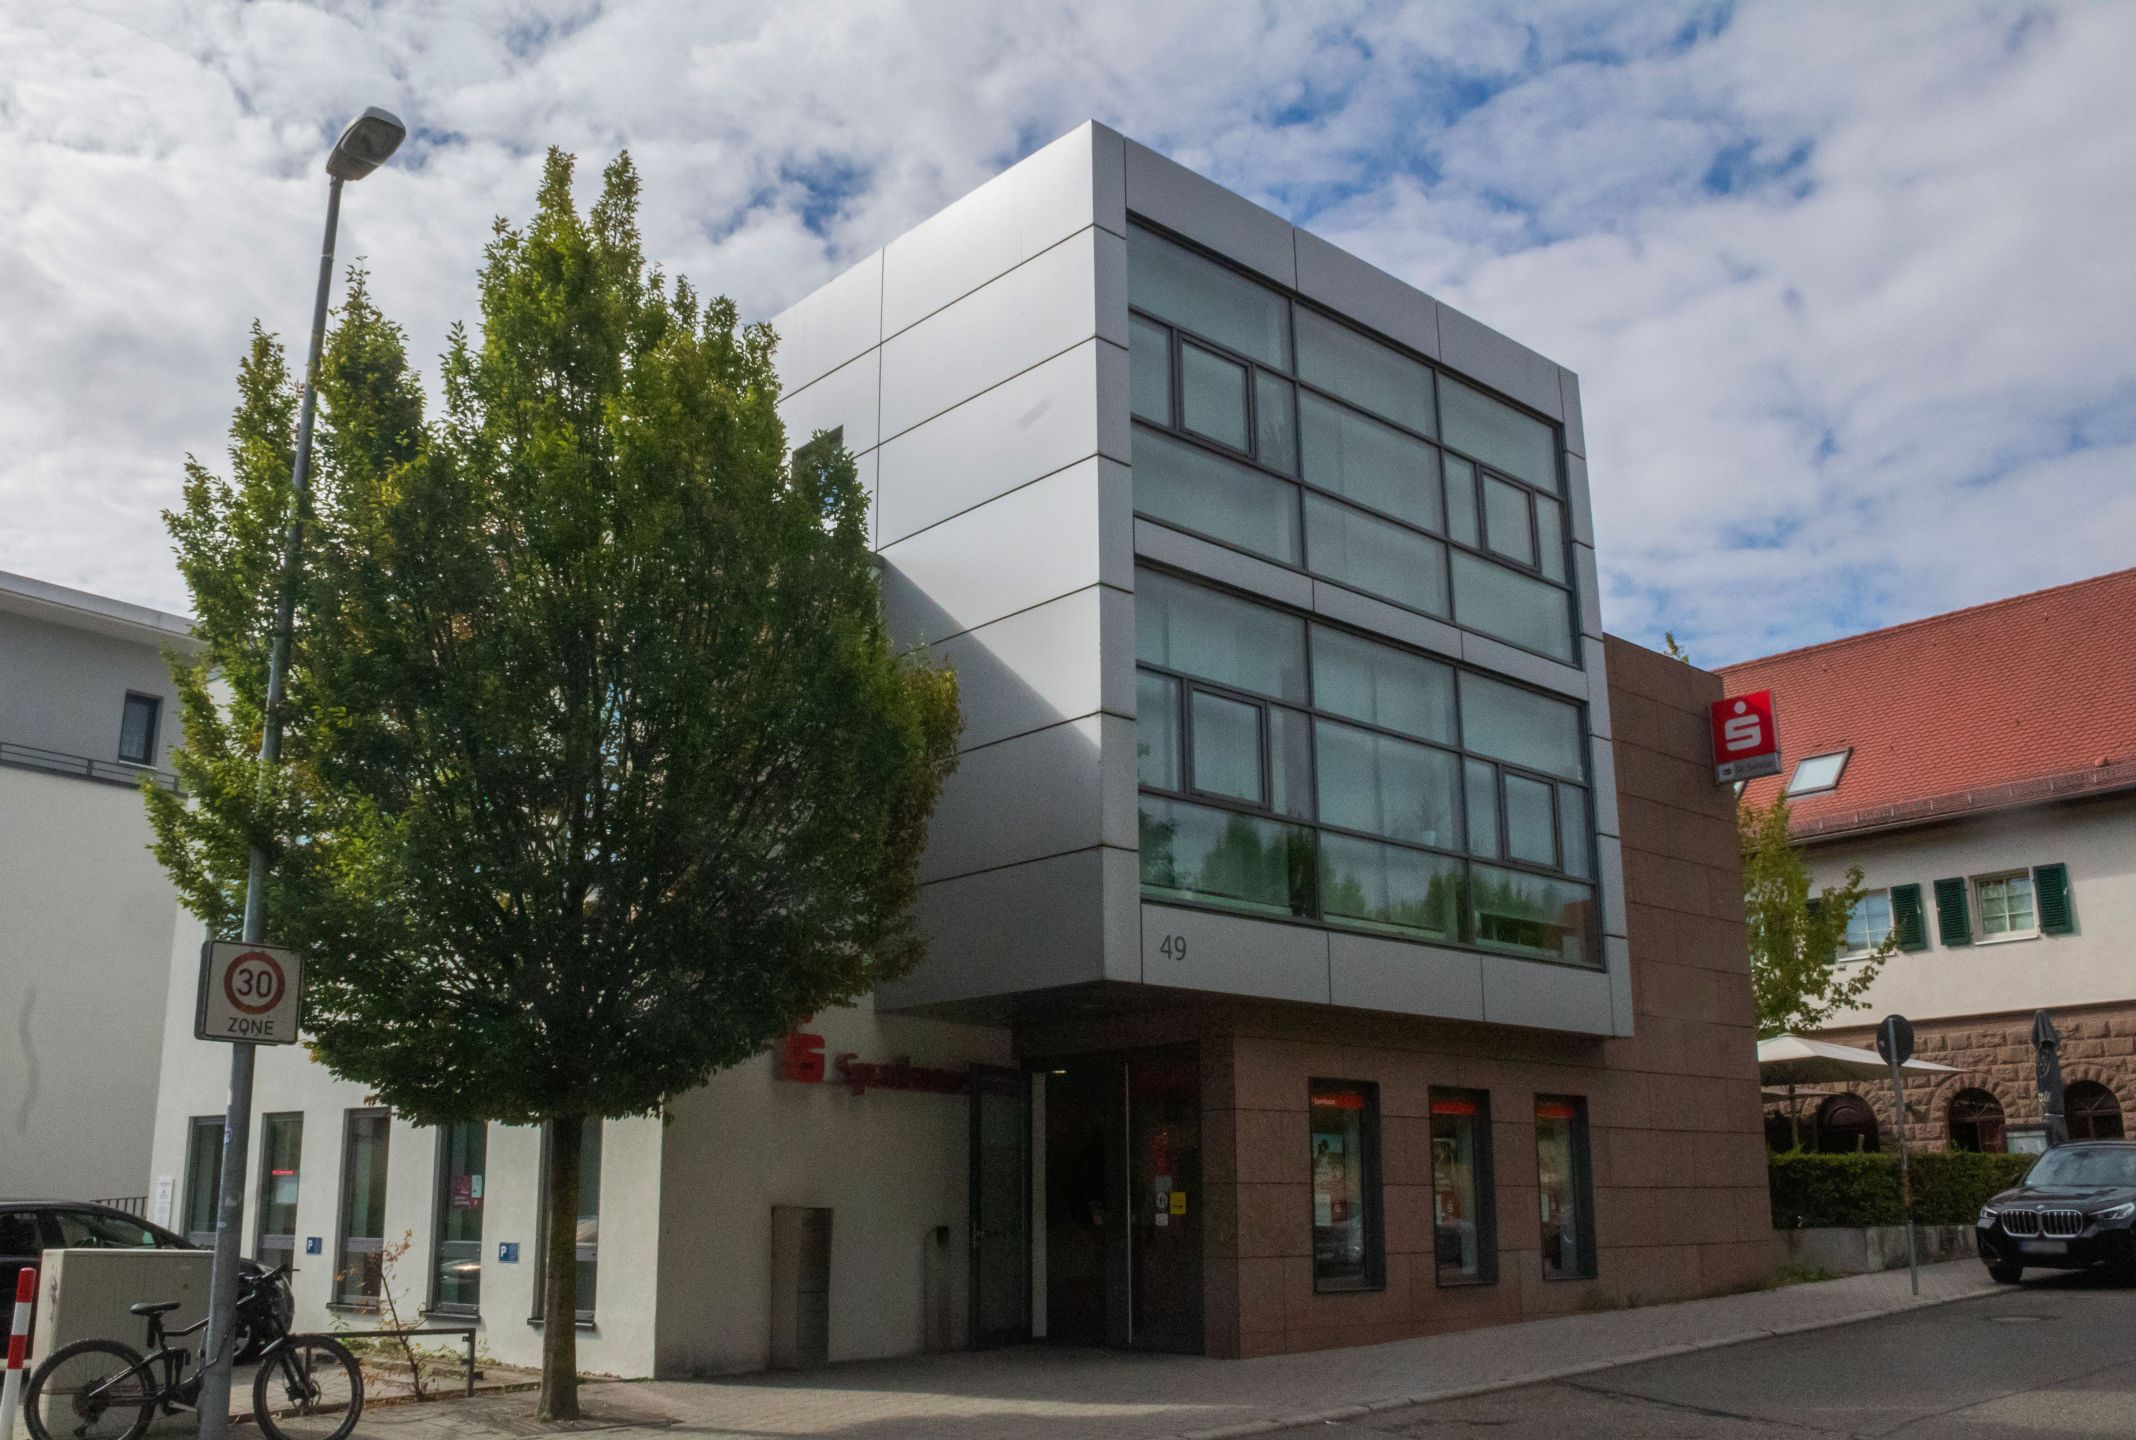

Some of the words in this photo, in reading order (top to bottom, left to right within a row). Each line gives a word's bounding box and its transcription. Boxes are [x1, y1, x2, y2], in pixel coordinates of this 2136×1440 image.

[1725, 712, 1762, 751] S
[1160, 934, 1186, 960] 49
[237, 967, 272, 998] 30
[228, 1016, 275, 1036] ZONE
[500, 1245, 507, 1257] P
